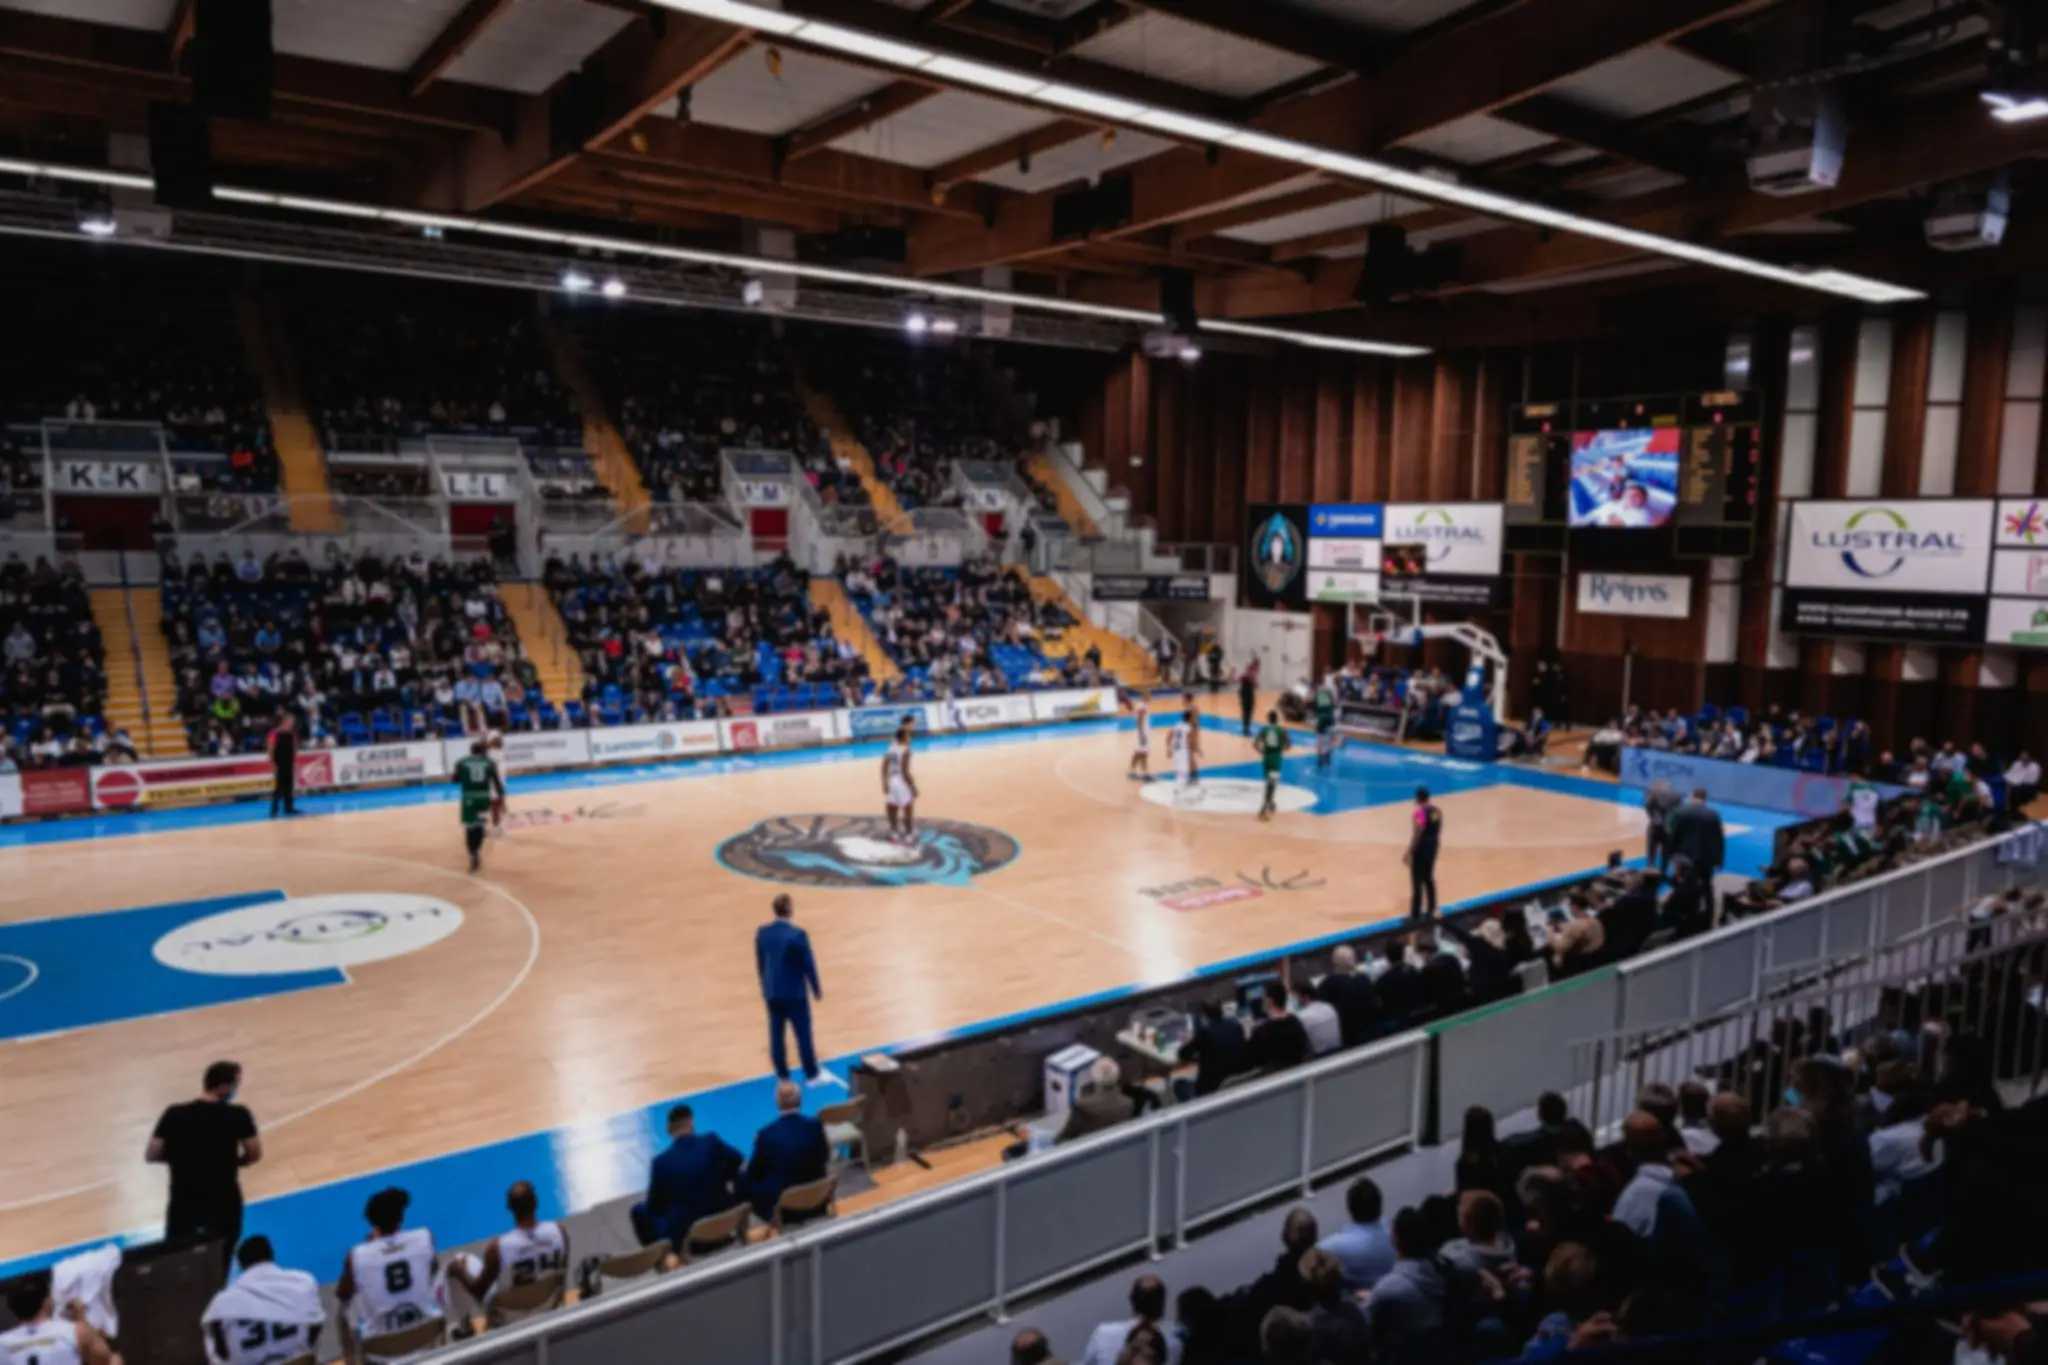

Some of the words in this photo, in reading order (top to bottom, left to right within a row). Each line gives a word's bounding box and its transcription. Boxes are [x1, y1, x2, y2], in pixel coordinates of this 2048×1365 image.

[70, 464, 93, 487] K
[116, 464, 138, 488] K
[449, 475, 464, 495] L
[483, 477, 498, 497] L
[1395, 525, 1483, 539] LUSTRAL
[1812, 530, 1961, 549] LUSTRAL
[1590, 573, 1669, 604] Reims
[355, 746, 408, 764] CAISSE
[384, 1260, 413, 1294] 8
[513, 1250, 563, 1286] 24
